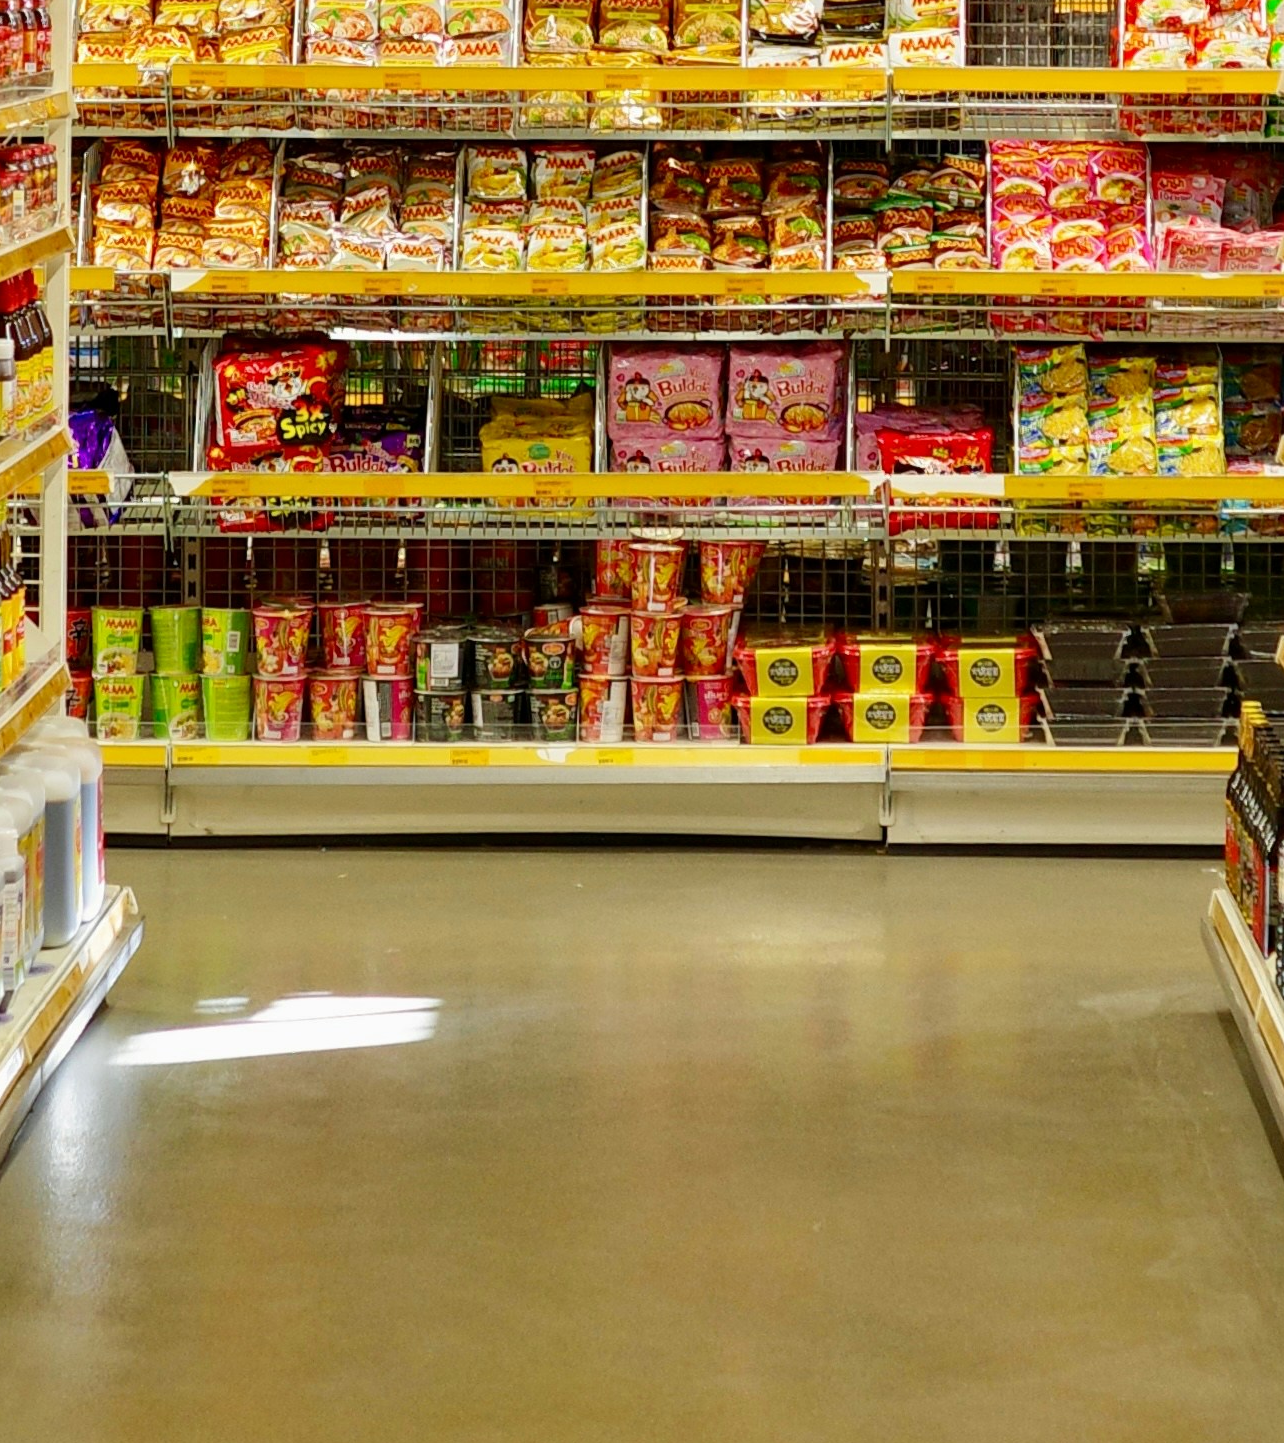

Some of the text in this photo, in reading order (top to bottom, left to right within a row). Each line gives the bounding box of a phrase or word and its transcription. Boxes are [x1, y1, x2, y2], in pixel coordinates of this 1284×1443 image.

[383, 42, 434, 56] MAMA
[900, 37, 955, 52] MAMA
[656, 379, 709, 398] Buldak
[777, 380, 829, 398] Buldak
[280, 419, 327, 440] Spicy
[330, 454, 388, 472] Buldak
[106, 617, 138, 629] MAMA
